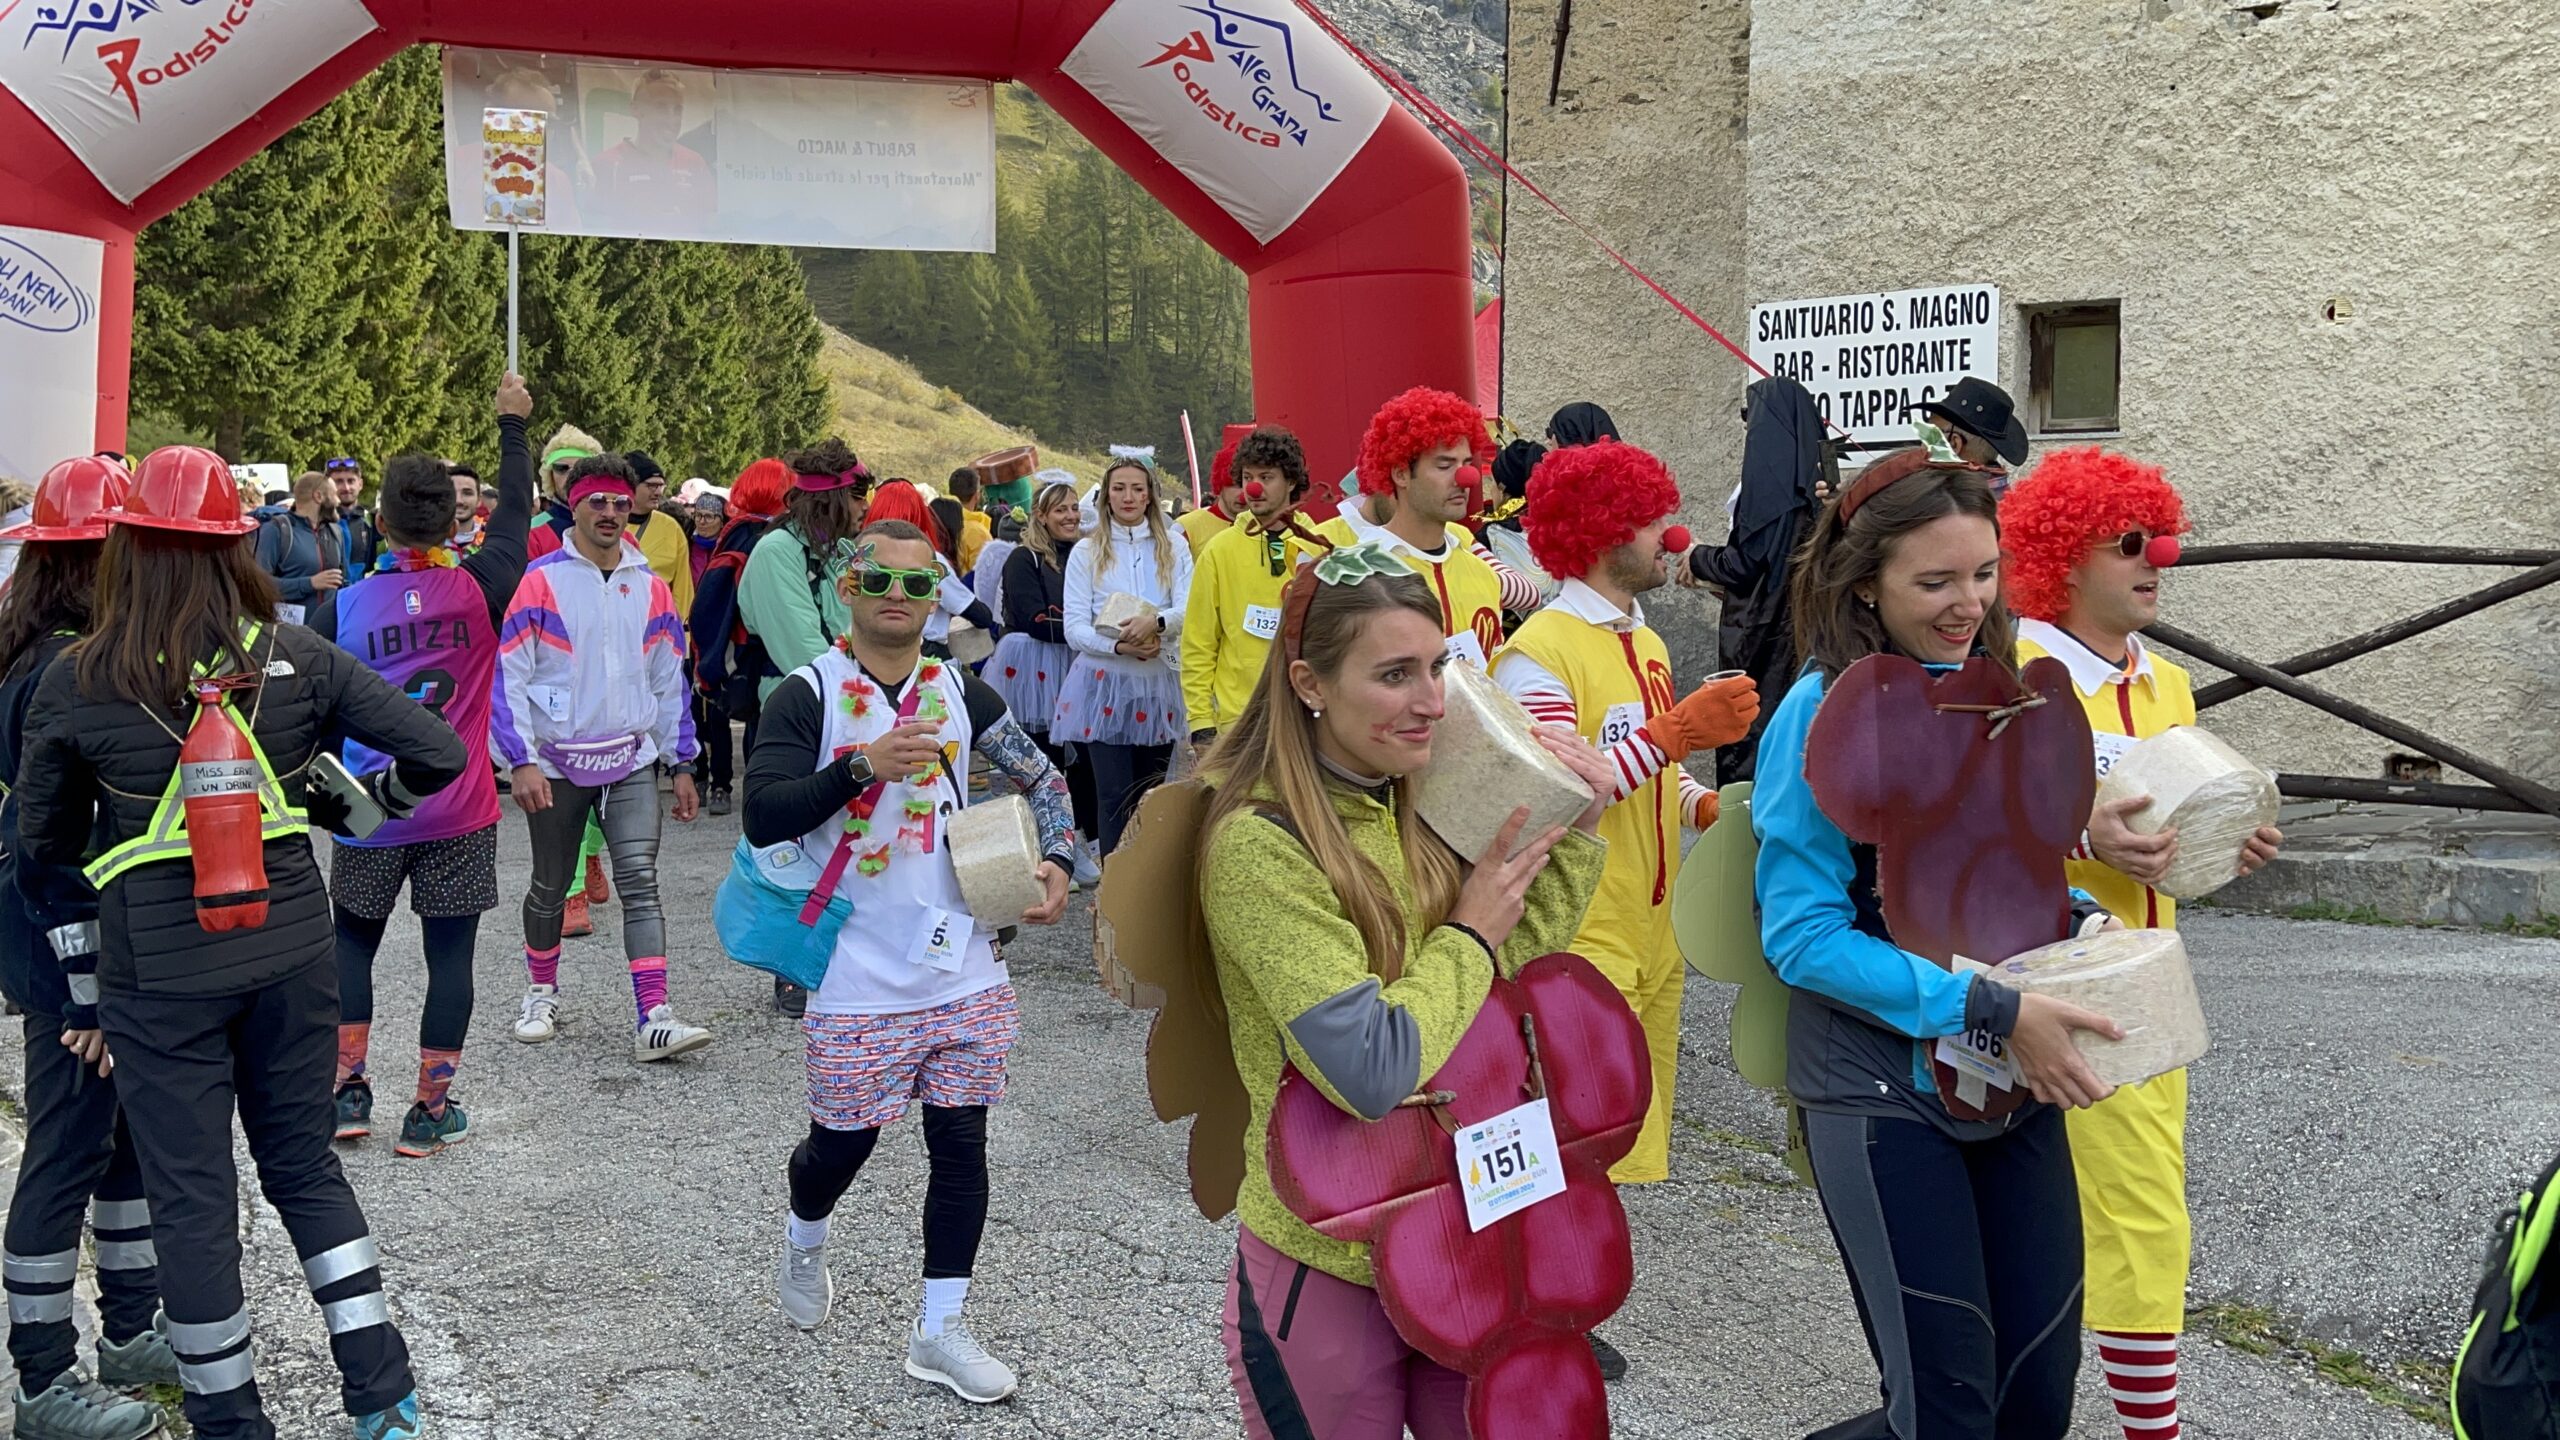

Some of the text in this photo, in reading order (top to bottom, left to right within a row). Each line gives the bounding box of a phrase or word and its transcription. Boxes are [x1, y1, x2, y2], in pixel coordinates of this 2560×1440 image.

[1758, 290, 1990, 342] SANTUARIO S. MAGNO
[1773, 350, 1814, 382] BAR
[1838, 338, 1972, 380] RISTORANTE
[1839, 387, 1912, 429] TAPPA
[367, 620, 471, 660] IBIZA
[1256, 618, 1277, 630] 132
[1602, 721, 1630, 744] 132
[201, 783, 218, 792] UN
